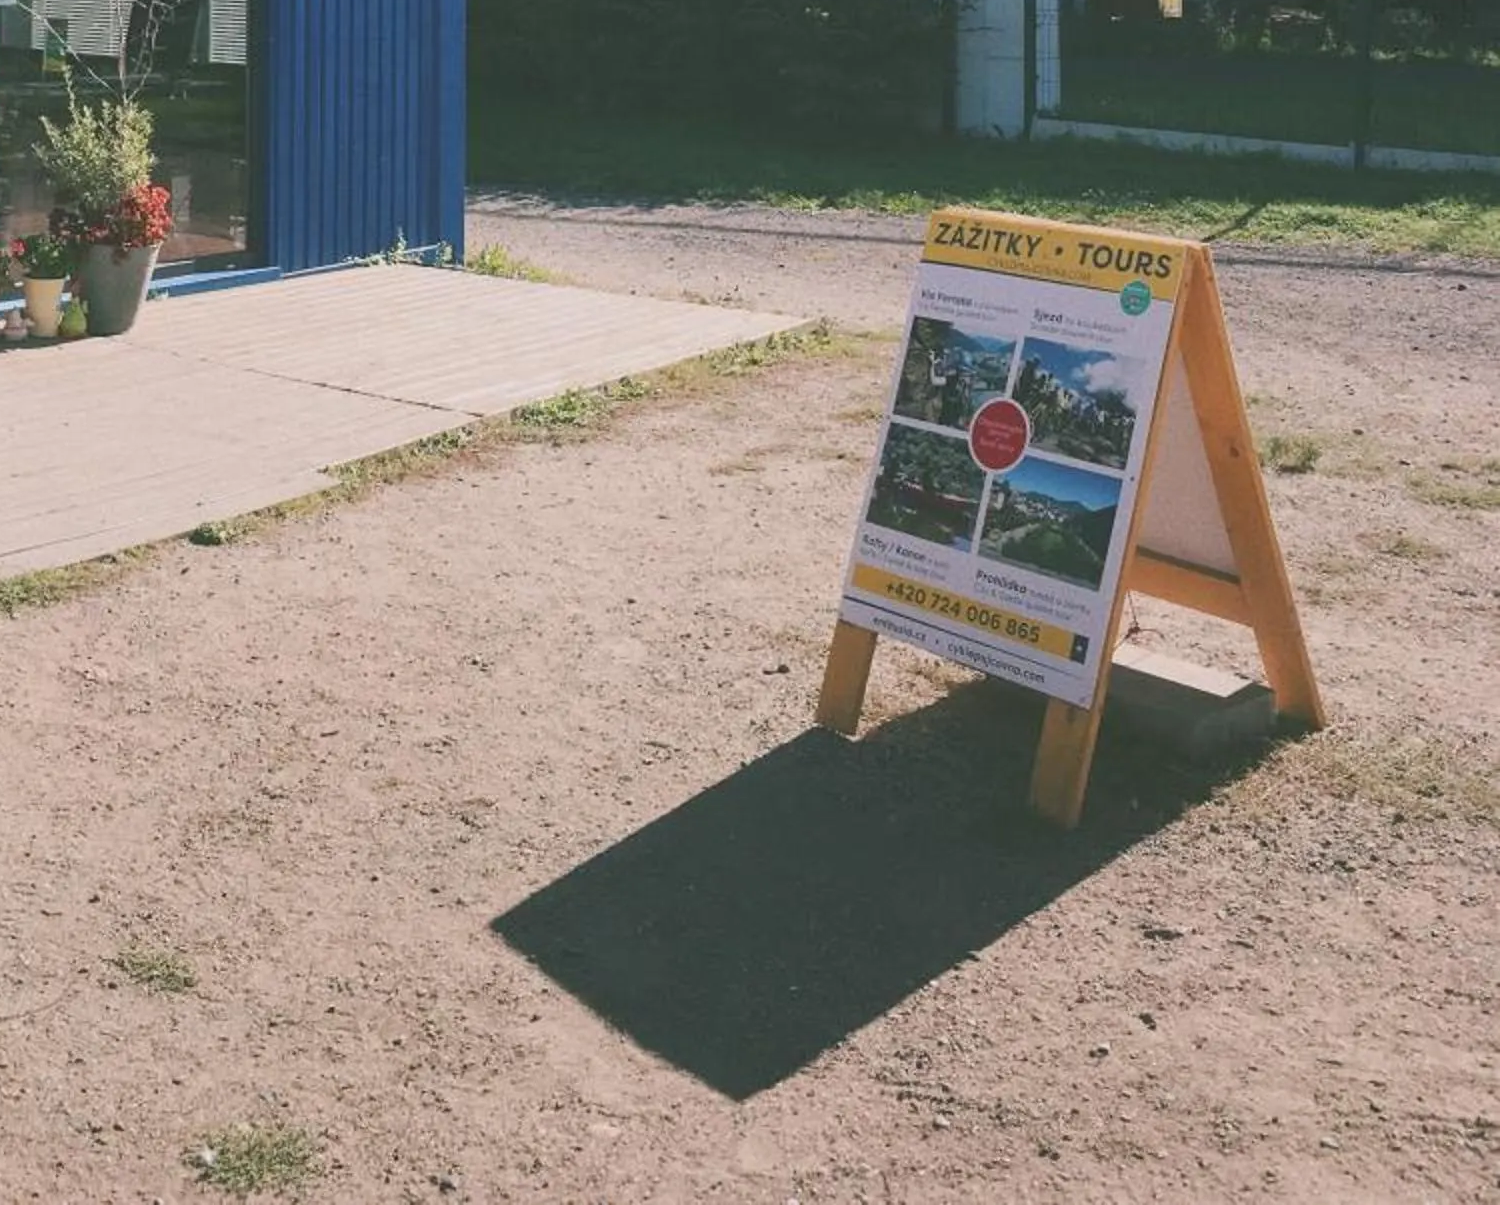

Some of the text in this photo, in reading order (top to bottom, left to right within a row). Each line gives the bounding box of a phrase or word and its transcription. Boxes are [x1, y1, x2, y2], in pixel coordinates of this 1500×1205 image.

[934, 219, 1172, 279] ZÁŽITKY TOURS
[886, 582, 926, 605] +420
[930, 592, 961, 617] 724
[967, 605, 1002, 630] 006
[1005, 619, 1041, 644] 865
